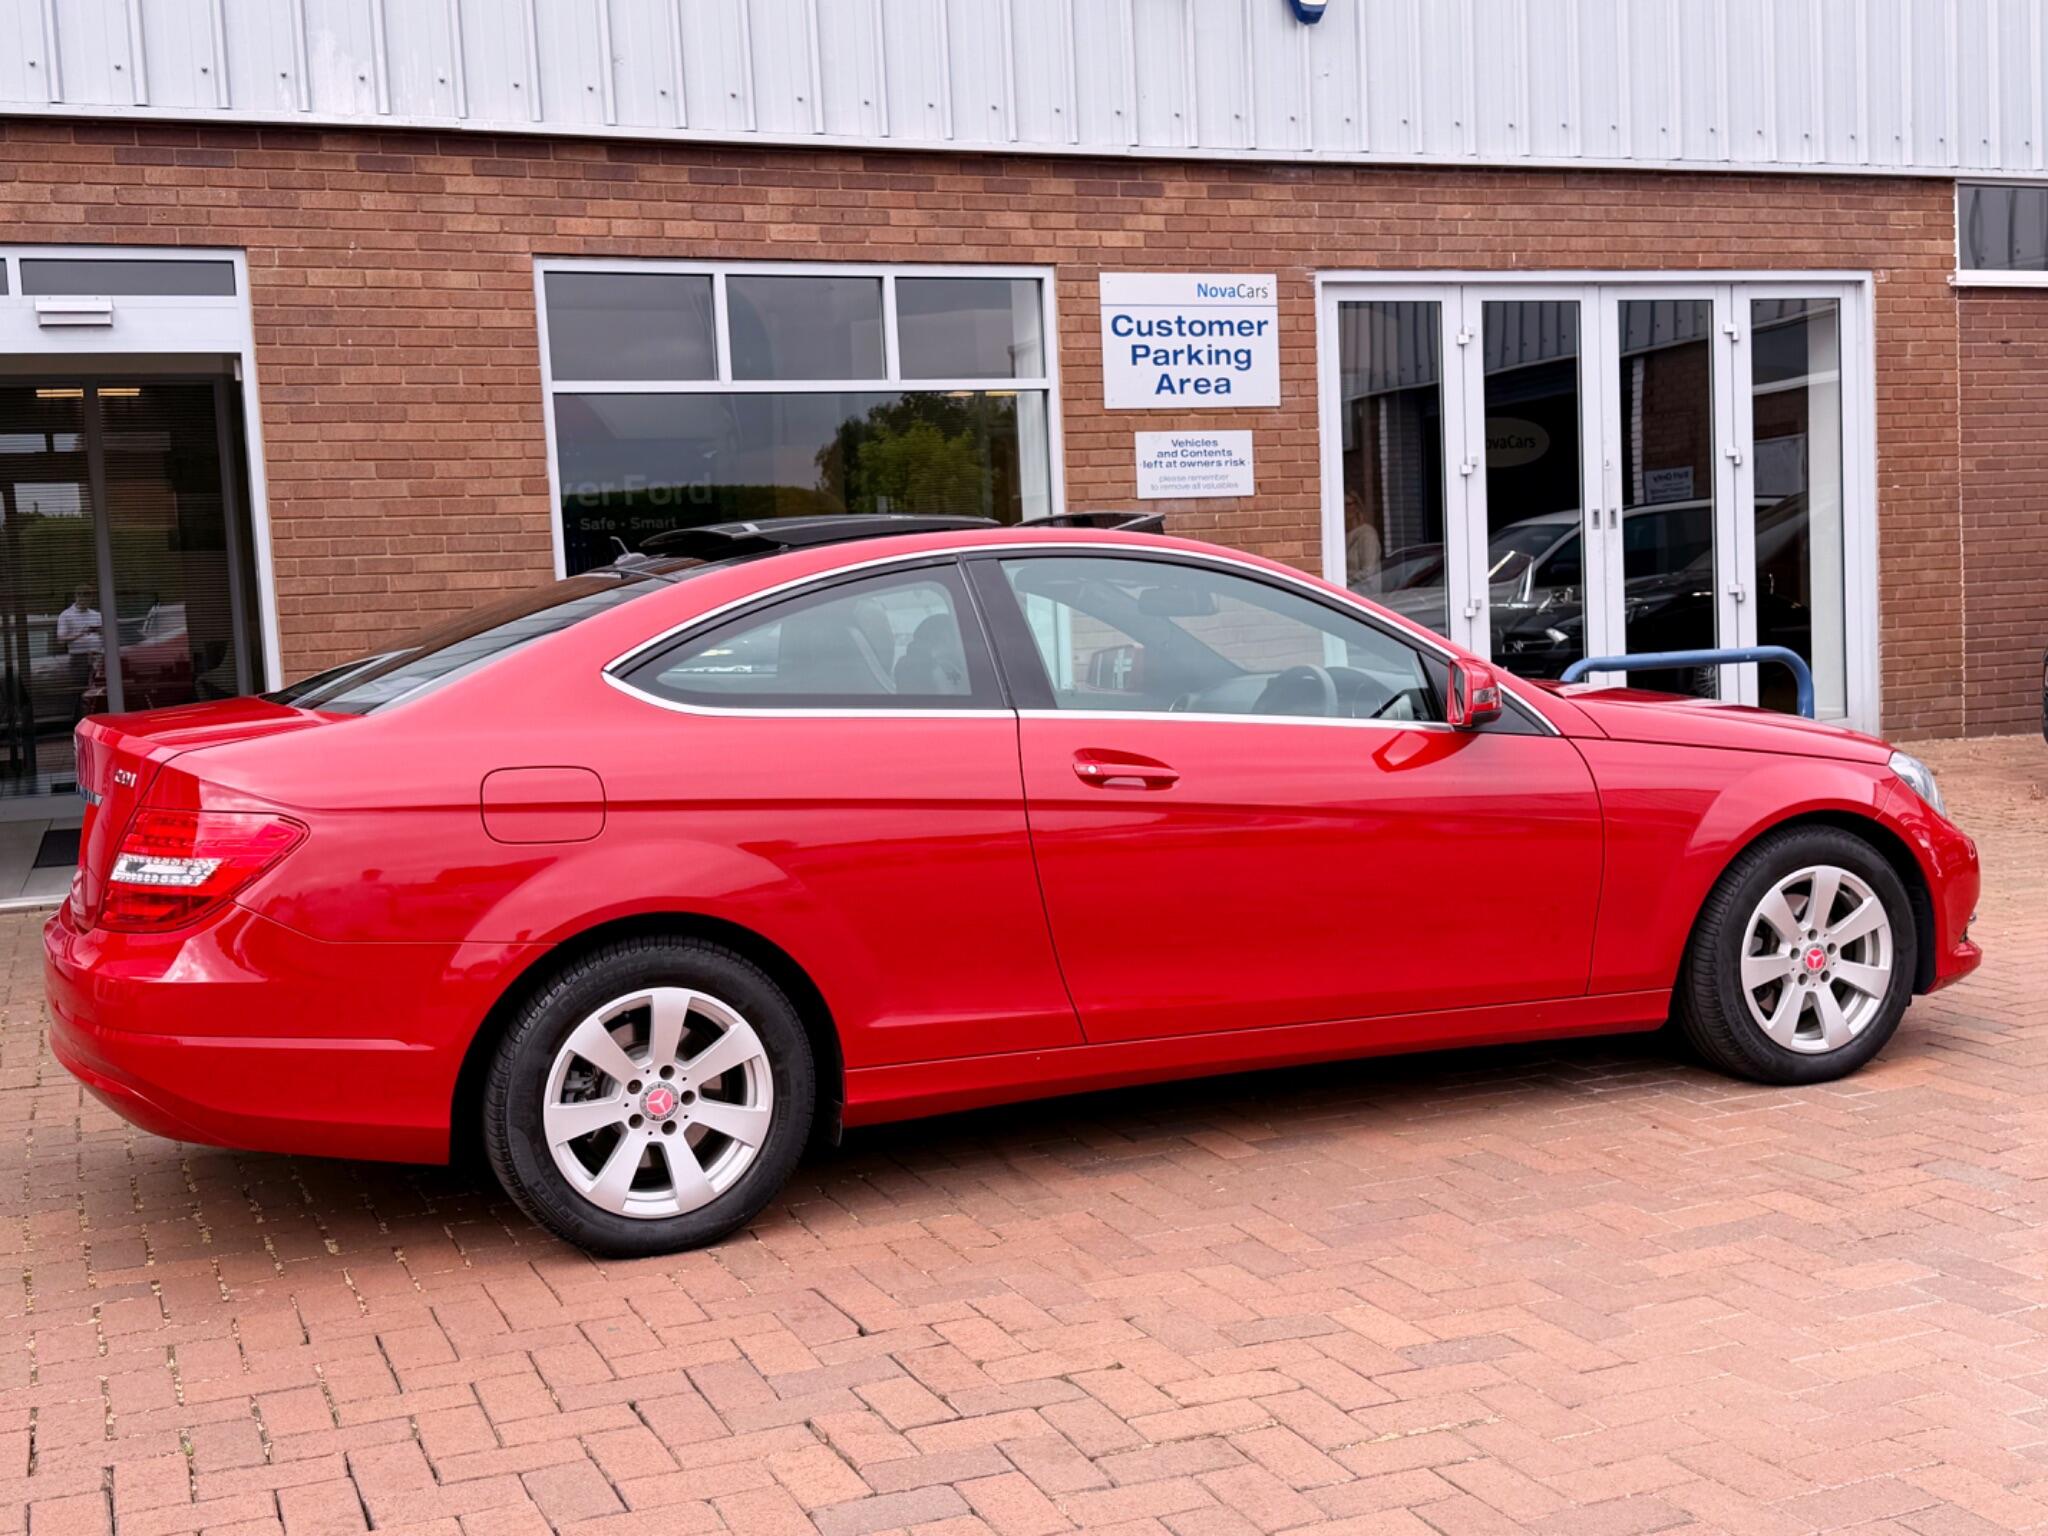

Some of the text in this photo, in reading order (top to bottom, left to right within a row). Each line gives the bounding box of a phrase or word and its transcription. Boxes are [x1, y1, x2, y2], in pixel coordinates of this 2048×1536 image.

[1197, 283, 1268, 298] NovaCars
[1111, 314, 1269, 337] Customer
[1131, 344, 1252, 371] Parking
[1155, 373, 1232, 395] Area
[1171, 439, 1218, 448] Vehicles
[1486, 434, 1537, 450] ovaCars
[1157, 449, 1233, 458] and Contents
[1143, 458, 1246, 468] left at owners risk
[623, 472, 713, 505] Ford
[580, 517, 678, 531] Safe Smart
